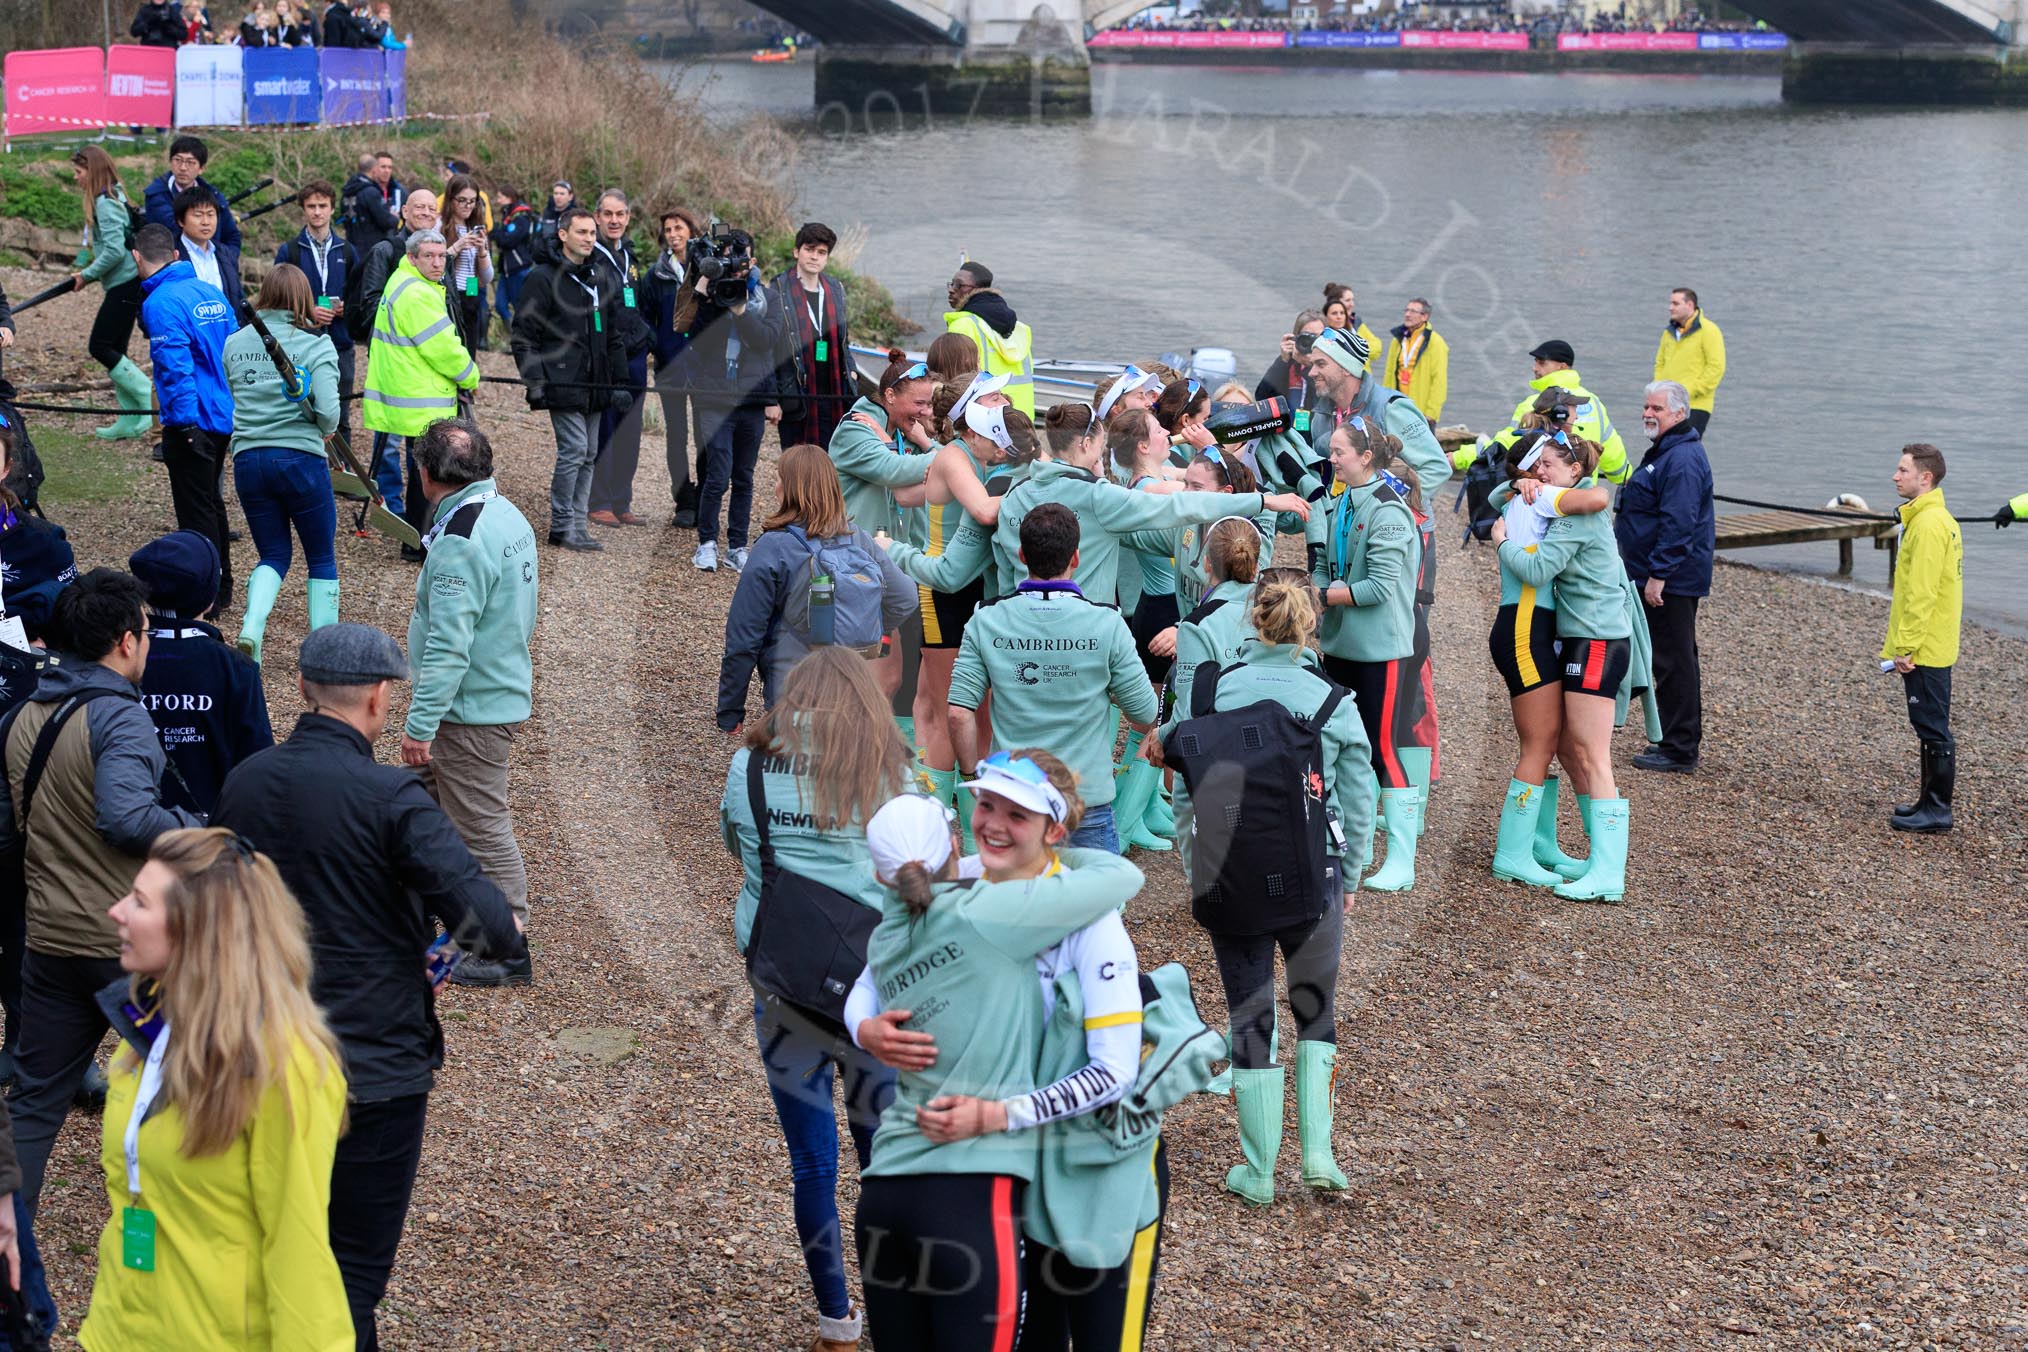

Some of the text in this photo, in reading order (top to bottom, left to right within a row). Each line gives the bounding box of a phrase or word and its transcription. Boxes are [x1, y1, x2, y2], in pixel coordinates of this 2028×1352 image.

[252, 77, 311, 95] smartwater
[198, 306, 224, 318] SWORD
[1227, 419, 1284, 439] CHAPEL DOWN
[57, 568, 74, 582] BOAT
[448, 578, 468, 587] RACE
[992, 637, 1100, 651] CAMBRIDGE
[1043, 664, 1071, 672] CANCER
[139, 694, 213, 711] XFORD
[1158, 683, 1167, 713] DOWN
[164, 727, 196, 735] CANCER
[164, 734, 205, 743] RESEARCH
[767, 807, 841, 831] NEWTON
[1030, 1063, 1118, 1122] NEWTON
